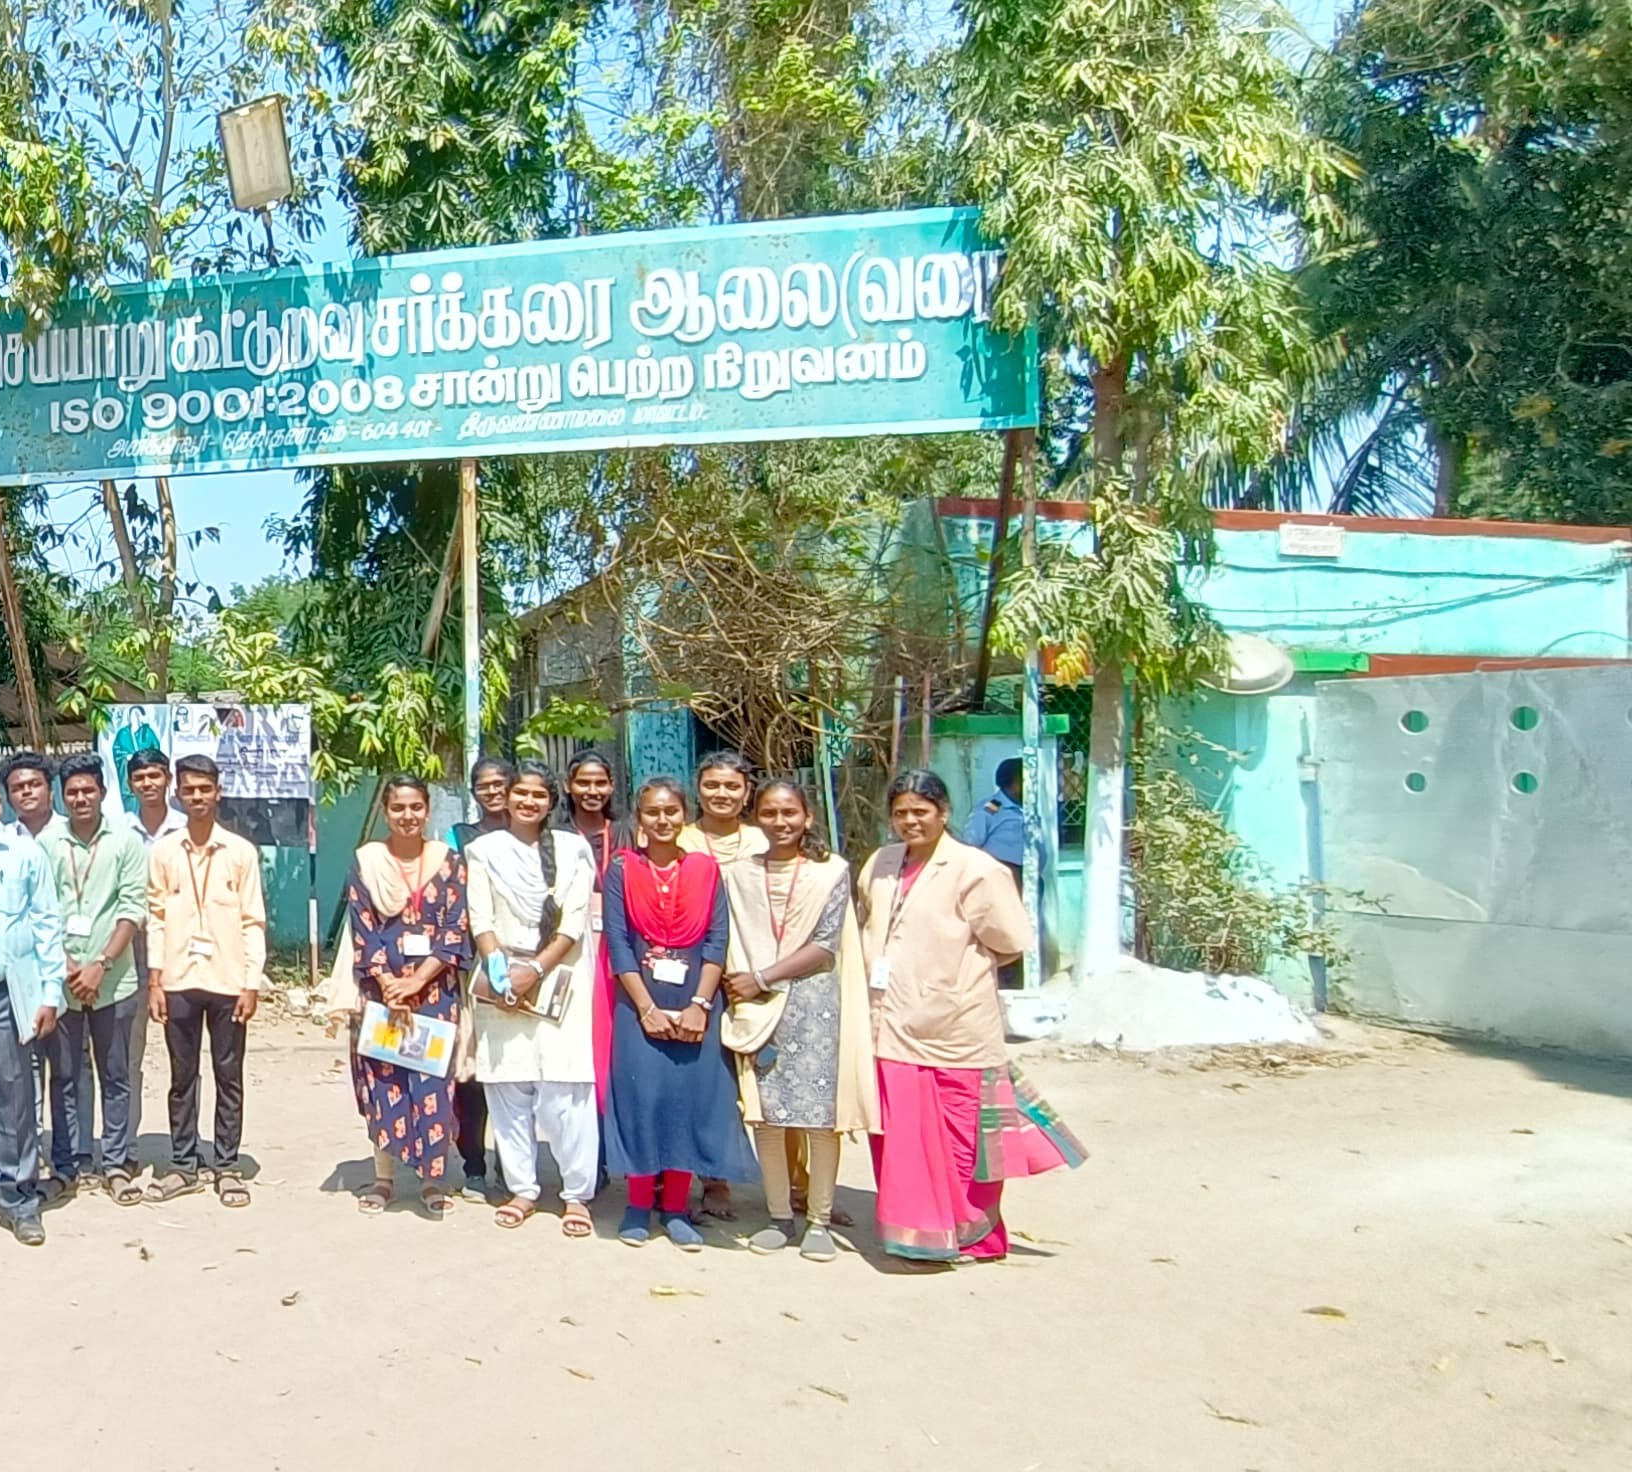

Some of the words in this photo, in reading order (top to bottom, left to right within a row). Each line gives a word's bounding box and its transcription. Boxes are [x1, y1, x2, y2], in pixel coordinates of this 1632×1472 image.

[171, 301, 365, 377] கூட்டுறவு
[371, 272, 616, 357] சர்க்கரை
[630, 262, 837, 343] ஆலை
[50, 397, 124, 434] ISO
[142, 374, 405, 429] 9001:2008
[409, 354, 562, 413] சான்று
[568, 344, 695, 402] பெற்ற
[703, 328, 927, 400] நிறுவனம்
